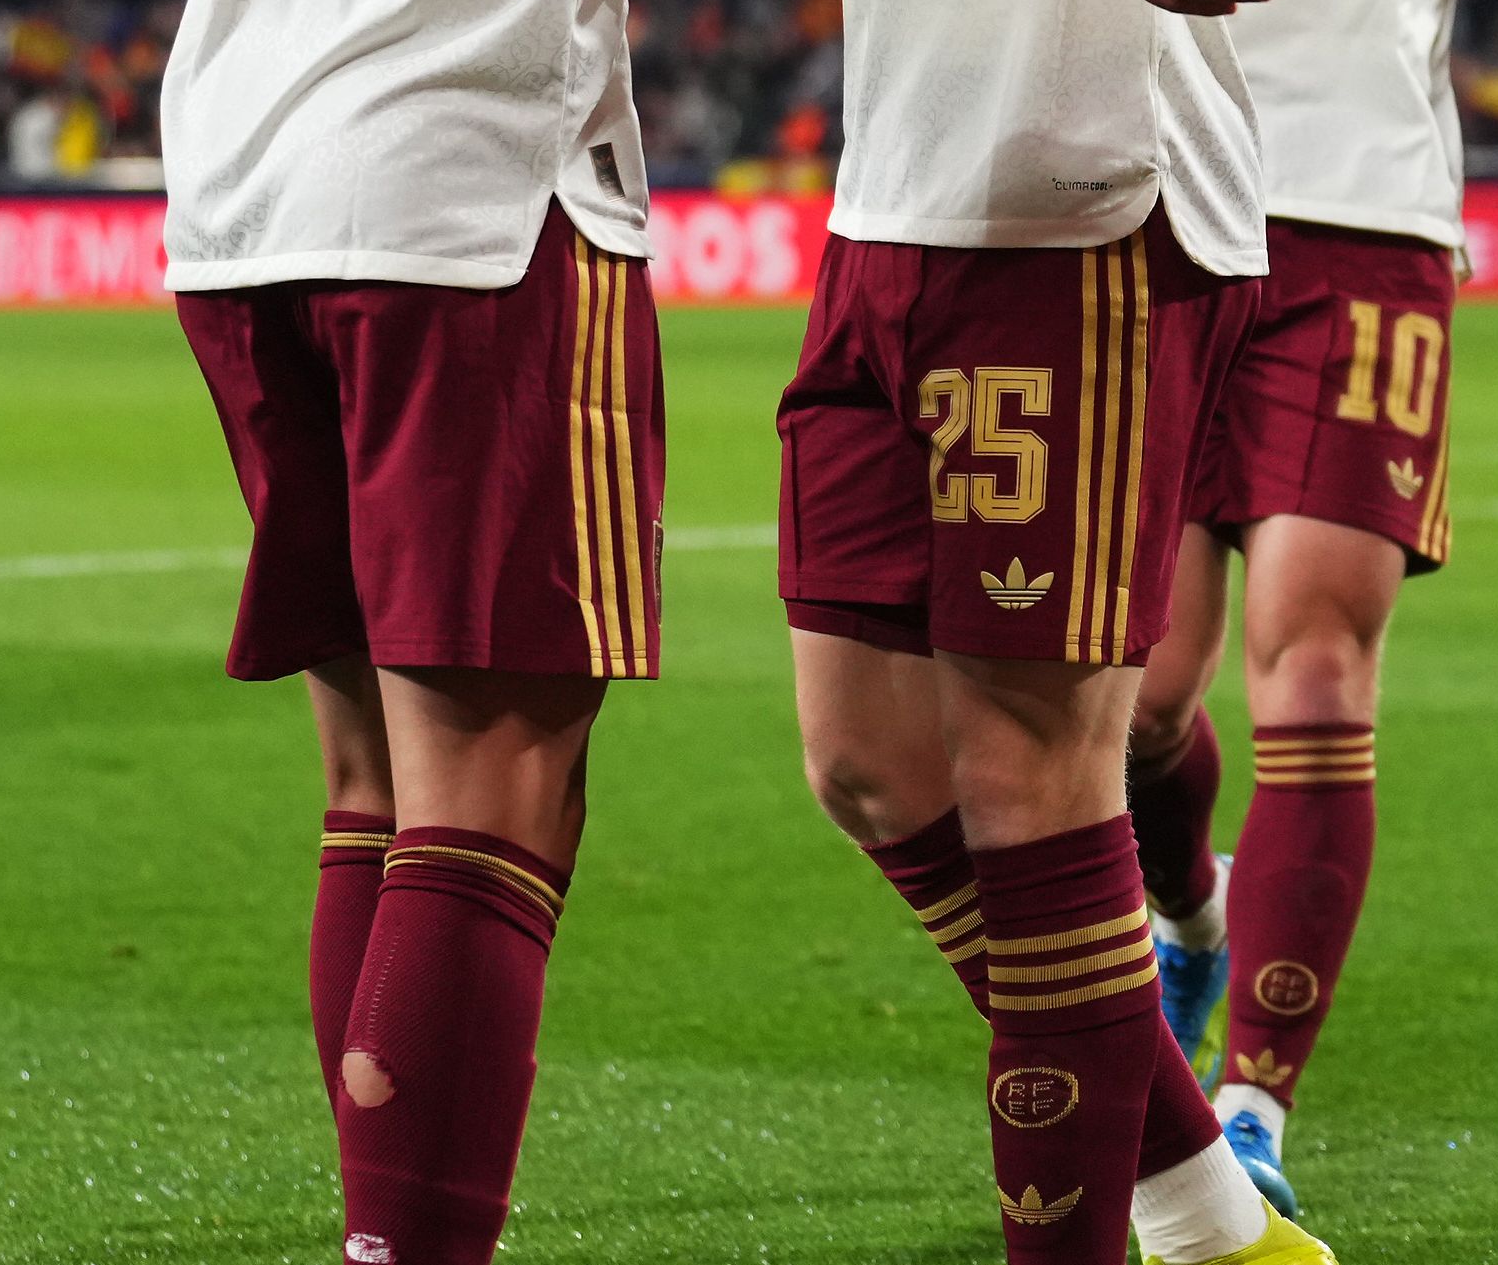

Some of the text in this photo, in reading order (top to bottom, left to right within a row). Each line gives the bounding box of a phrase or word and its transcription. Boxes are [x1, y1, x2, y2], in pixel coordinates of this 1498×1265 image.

[1336, 299, 1445, 438] 10
[917, 366, 1054, 525] 25
[1007, 1080, 1055, 1097] RF
[1008, 1098, 1055, 1115] EF
